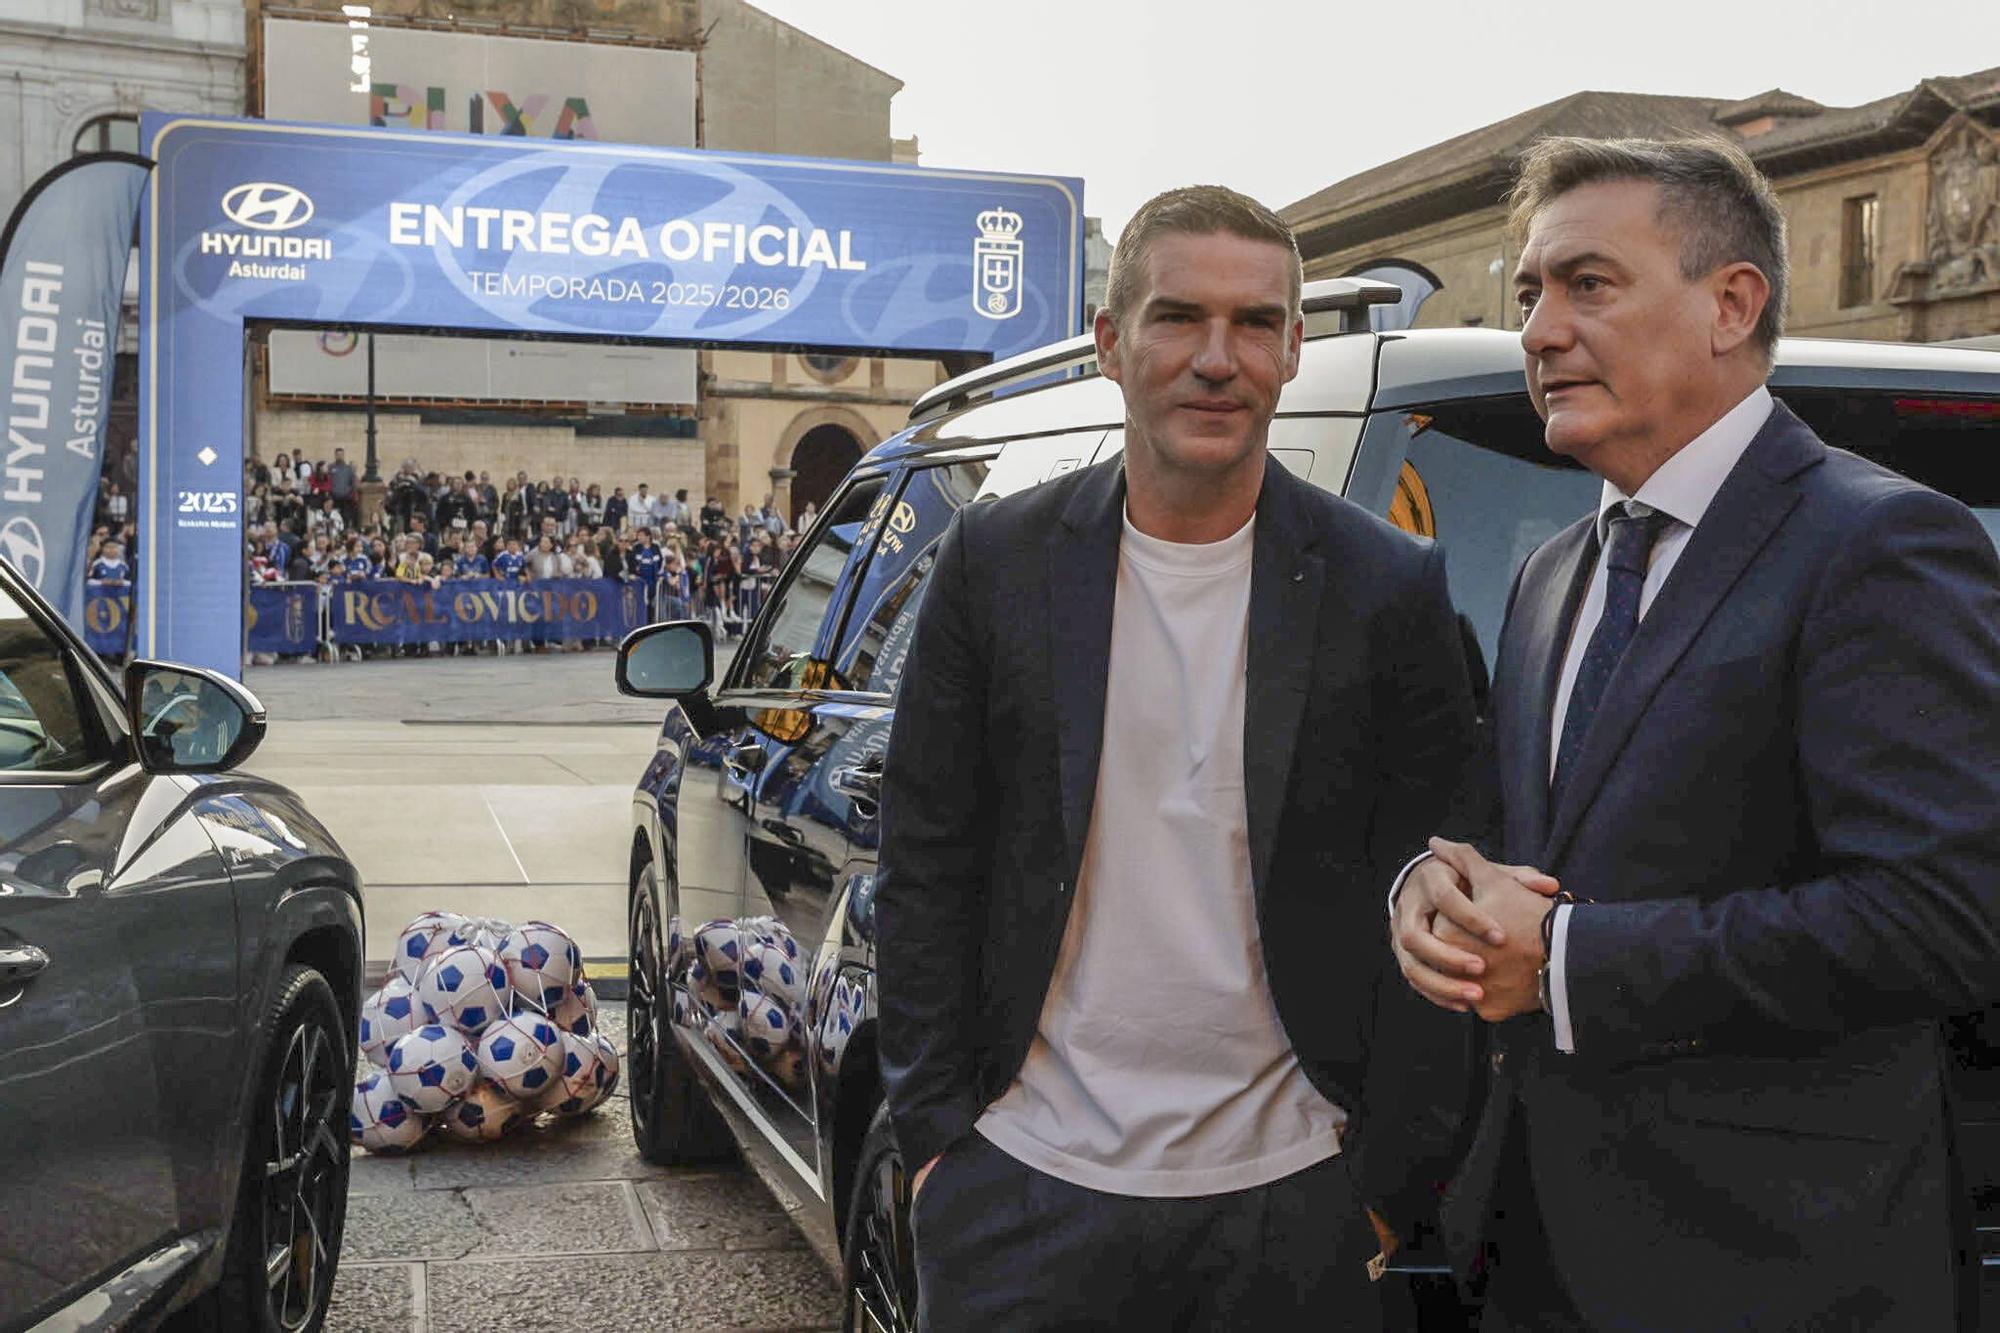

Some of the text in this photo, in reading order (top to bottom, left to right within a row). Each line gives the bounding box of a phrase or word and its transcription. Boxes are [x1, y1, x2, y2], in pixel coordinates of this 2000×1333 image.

[202, 232, 332, 260] HYUNDAI
[390, 203, 866, 270] ENTREGA OFICIAL
[229, 260, 306, 281] Asturdai
[468, 271, 790, 310] TEMPORADA 2025/2026
[4, 261, 64, 503] HYUNDAI
[65, 318, 107, 460] Asturdai
[178, 491, 237, 513] 2025
